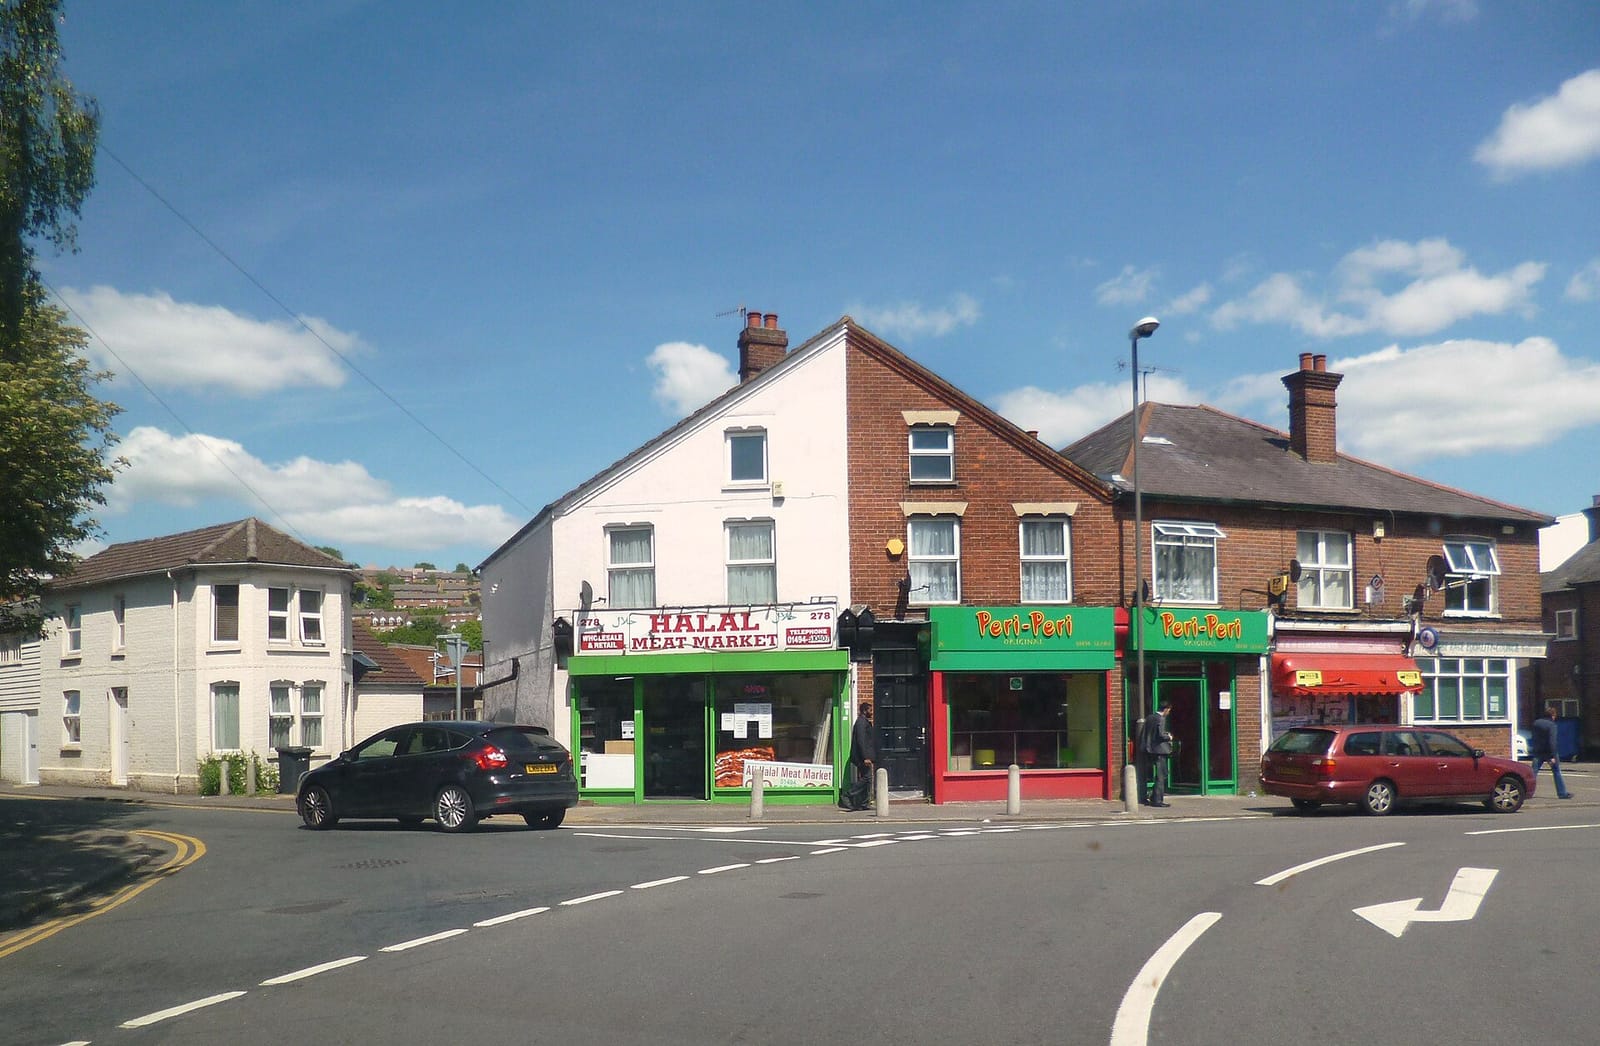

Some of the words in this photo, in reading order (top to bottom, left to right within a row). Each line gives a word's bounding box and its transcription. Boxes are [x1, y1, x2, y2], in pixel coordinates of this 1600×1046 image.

[580, 618, 600, 627] 278
[649, 612, 760, 633] HALAL
[810, 612, 831, 620] 278
[976, 610, 1073, 636] Peri-Peri
[1160, 611, 1242, 639] Peri-Peri
[582, 634, 623, 642] WHOLESALE
[594, 641, 618, 649] RETAIL
[632, 637, 687, 650] MEAT
[692, 634, 778, 649] MARKET
[781, 767, 801, 779] Meat
[803, 769, 832, 781] Market
